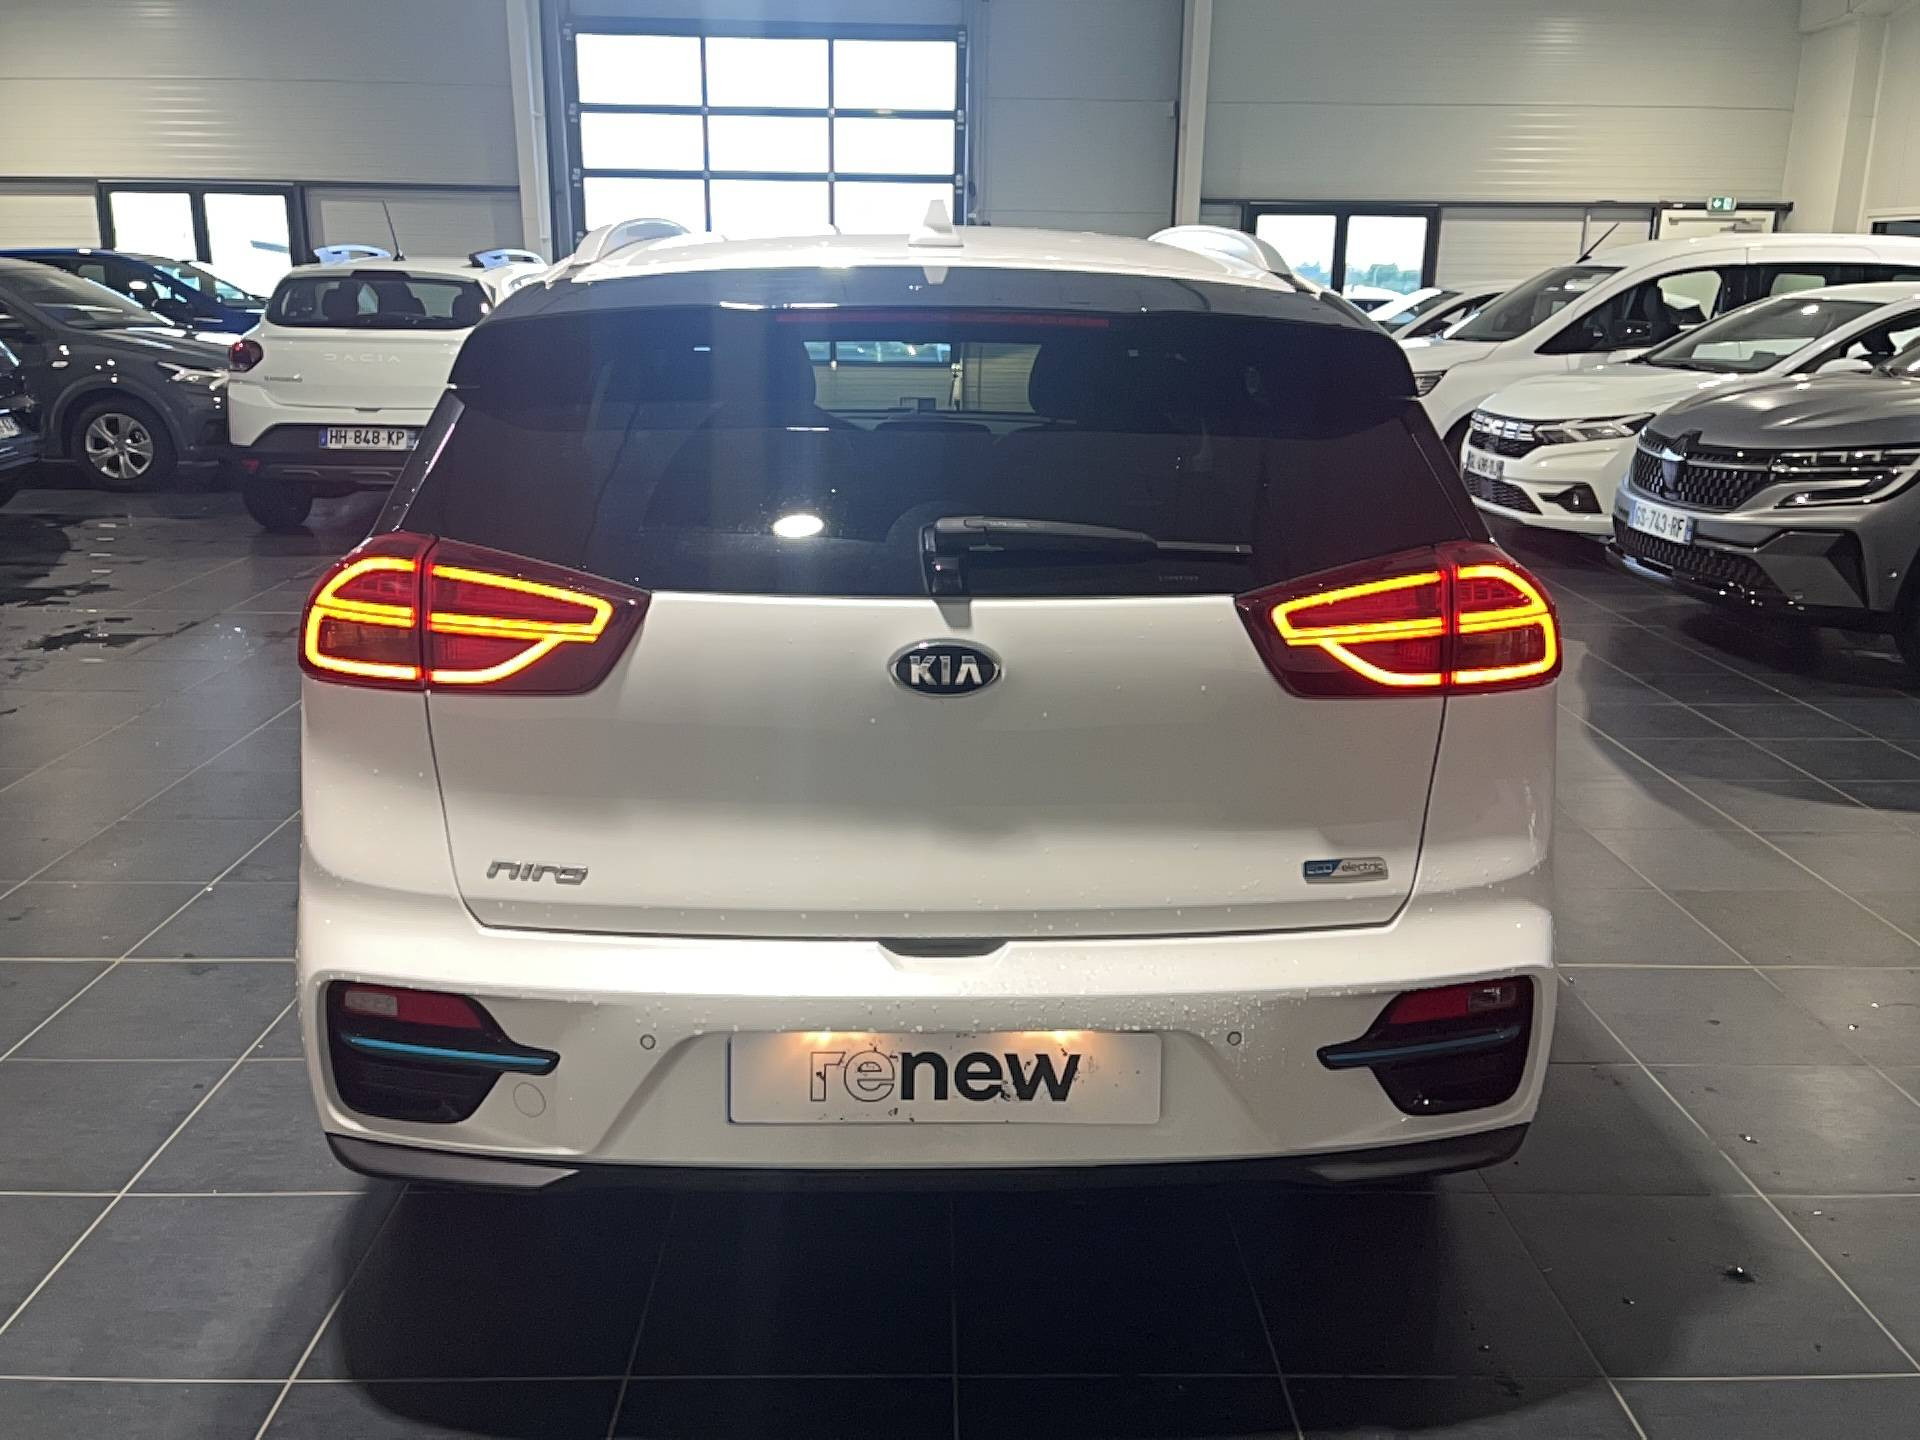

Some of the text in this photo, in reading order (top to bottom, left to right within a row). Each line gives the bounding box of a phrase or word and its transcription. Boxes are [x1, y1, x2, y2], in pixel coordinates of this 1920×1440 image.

[909, 655, 983, 685] KIA
[486, 861, 589, 886] niro
[811, 1050, 1081, 1102] renew
